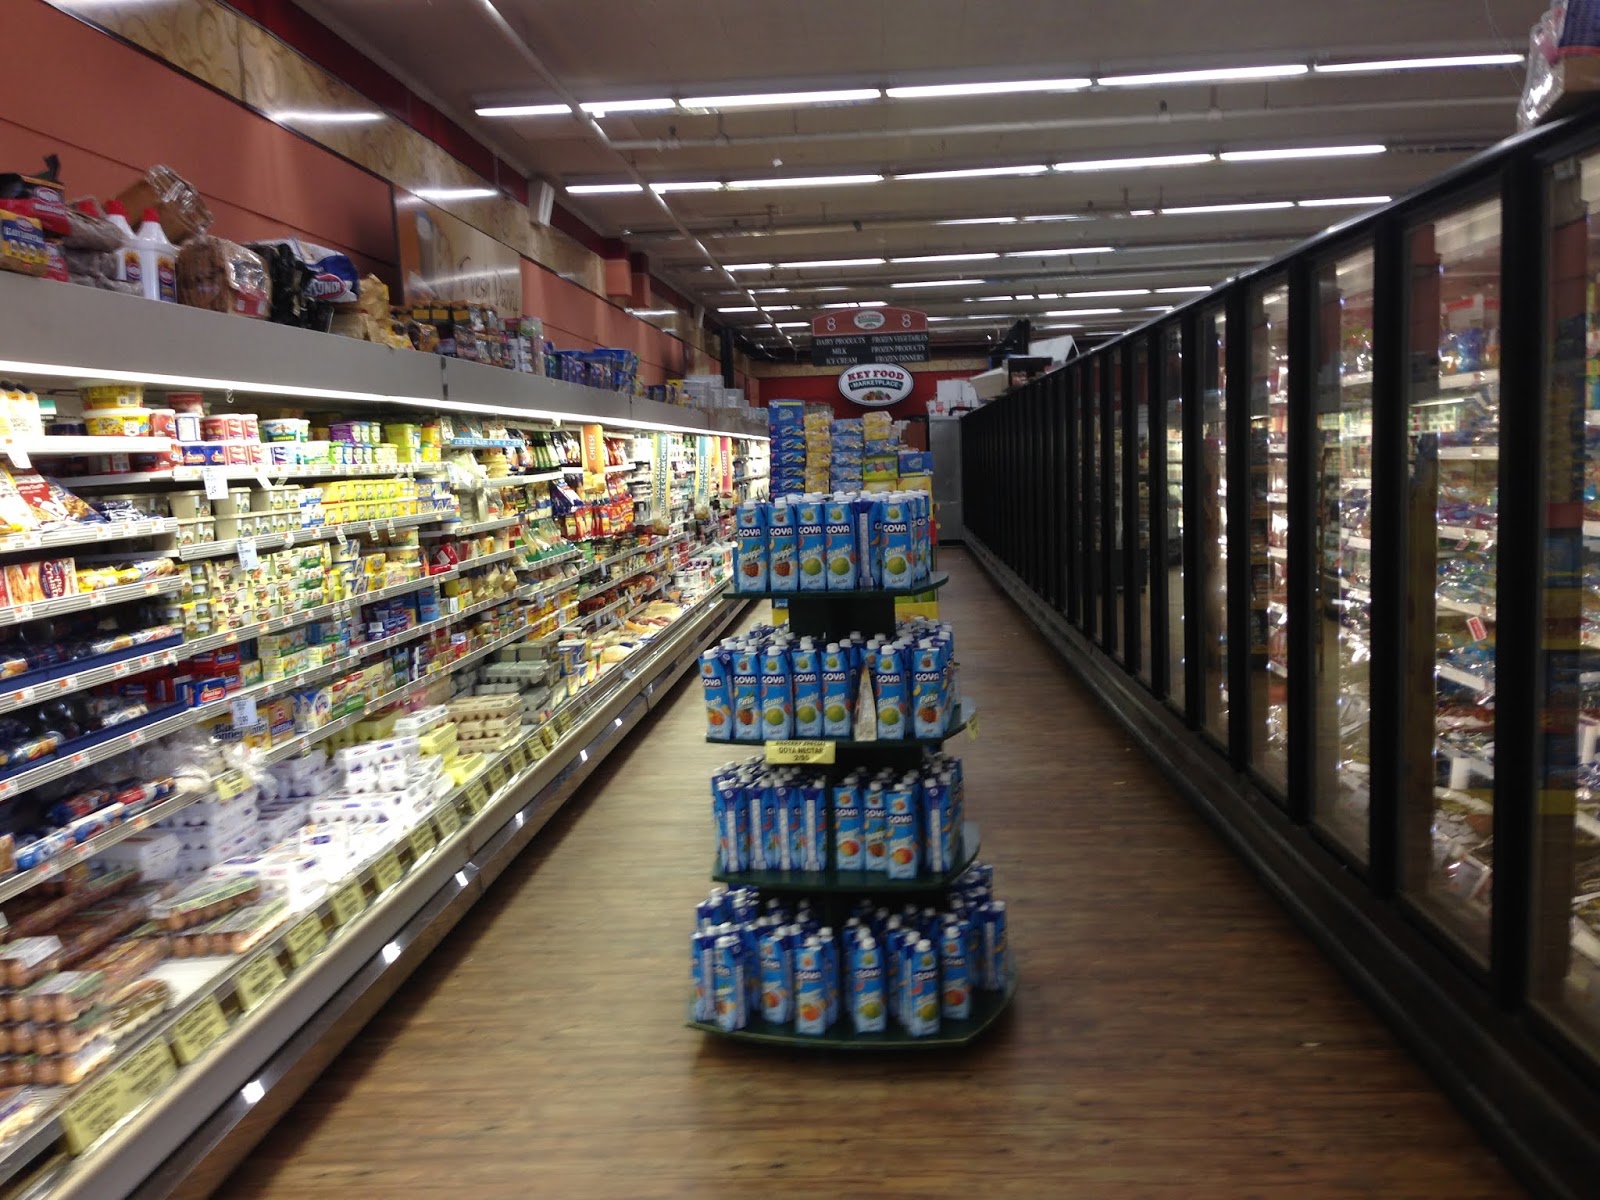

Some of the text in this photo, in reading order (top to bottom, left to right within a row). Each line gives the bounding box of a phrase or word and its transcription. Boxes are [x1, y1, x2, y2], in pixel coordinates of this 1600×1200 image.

[826, 316, 837, 332] 8
[901, 313, 912, 328] 8
[816, 336, 866, 346] DAIRY PRODUCTS
[871, 336, 894, 344] FROZEN
[894, 344, 926, 352] PRODUCTS
[826, 356, 858, 365] ICE CREAM
[875, 353, 925, 363] FROZEN DINNERS
[847, 370, 905, 381] KEY FOOD
[853, 379, 899, 389] MARKETPLACE
[738, 528, 761, 537] GOYA
[769, 527, 793, 536] GOYA
[798, 526, 822, 535] GOYA
[826, 525, 850, 534] GOYA
[883, 524, 907, 533] GOYA
[734, 676, 757, 684] GOYA
[762, 675, 785, 684] GOYA
[793, 674, 817, 682] GOYA
[822, 672, 846, 681] GOYA
[876, 674, 900, 683] GOYA
[915, 672, 940, 681] GOYA
[271, 721, 293, 735] IMPERIAL
[778, 746, 824, 754] GOYA NECTAR
[835, 808, 858, 817] GOYA
[888, 815, 913, 823] GOYA
